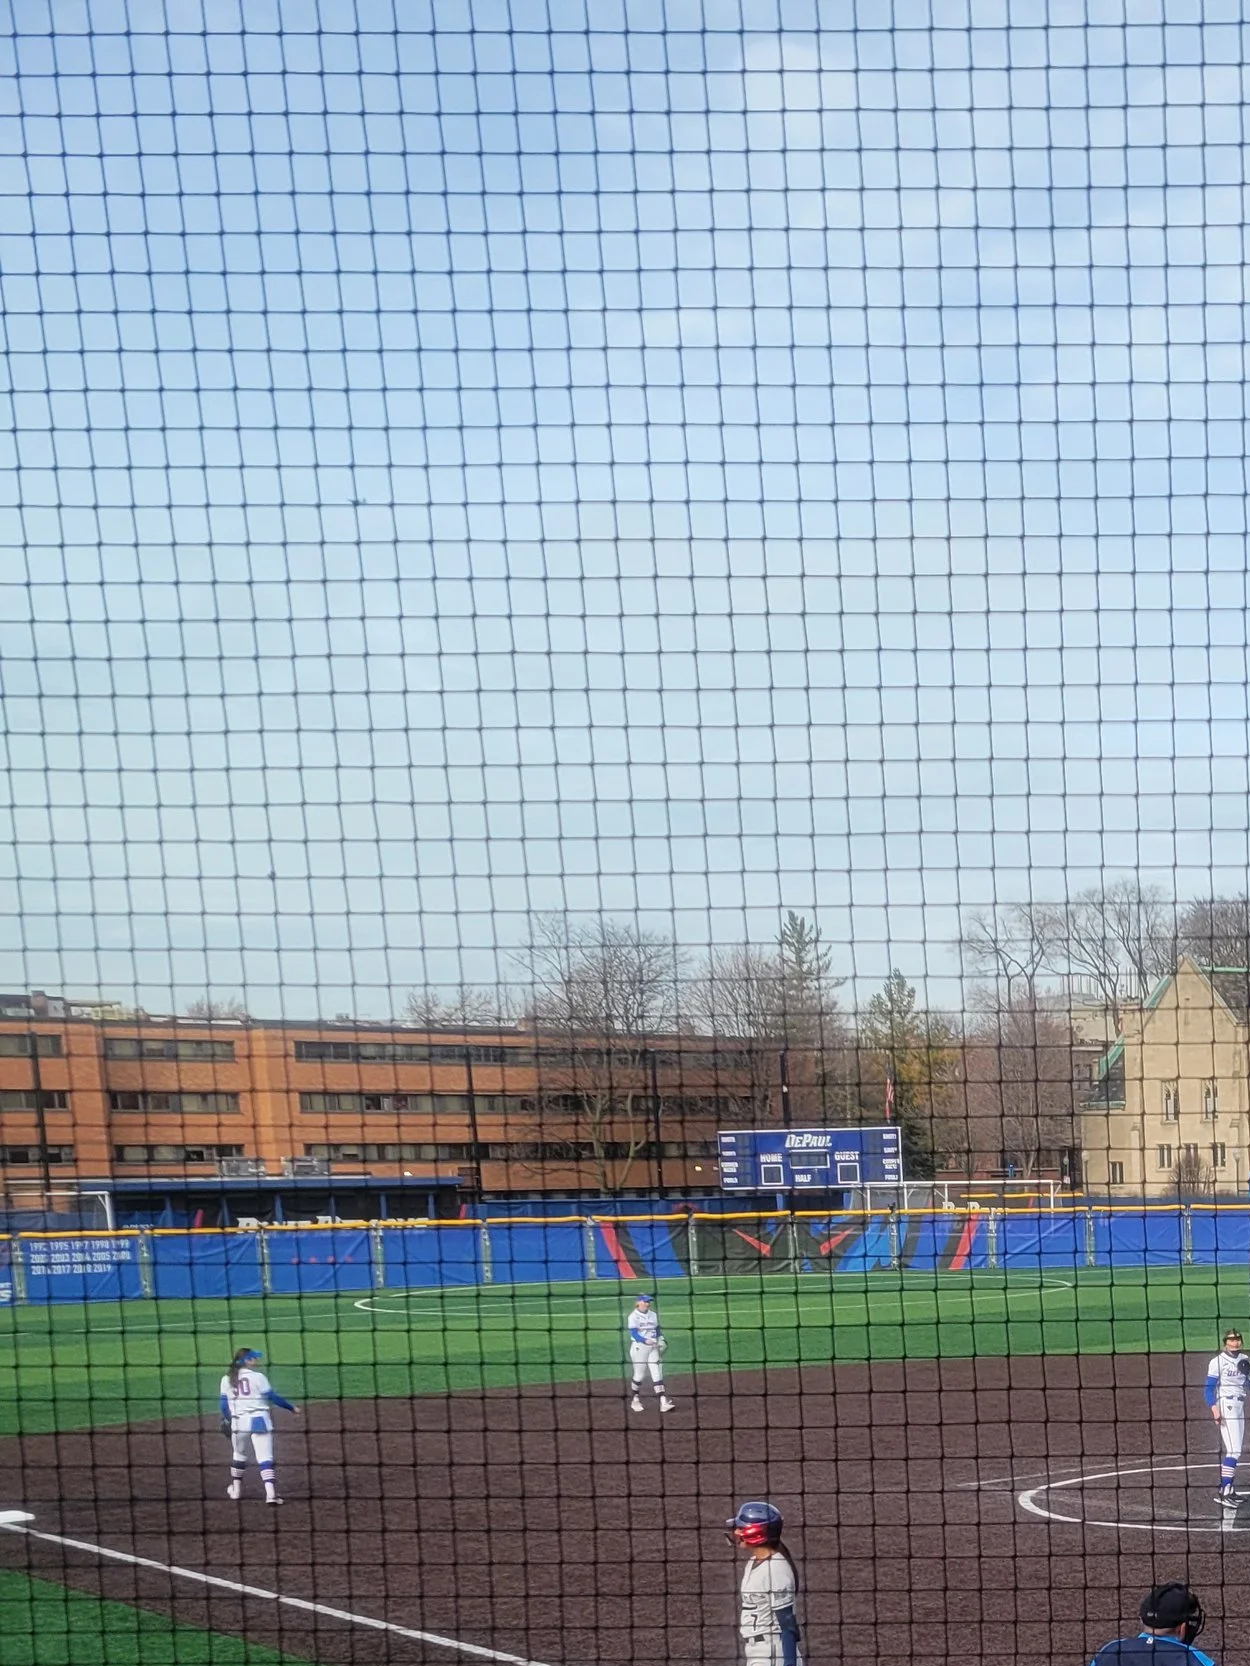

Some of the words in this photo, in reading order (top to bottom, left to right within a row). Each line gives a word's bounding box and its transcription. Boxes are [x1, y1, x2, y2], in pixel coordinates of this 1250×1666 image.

[784, 1133, 833, 1148] DEPAUL
[760, 1153, 783, 1163] HOME
[834, 1151, 860, 1161] GUEST
[794, 1174, 812, 1183] HALF
[92, 1251, 111, 1261] 2005
[52, 1264, 71, 1275] 2017
[93, 1264, 112, 1273] 2019
[232, 1377, 251, 1397] 0
[750, 1613, 758, 1632] 7
